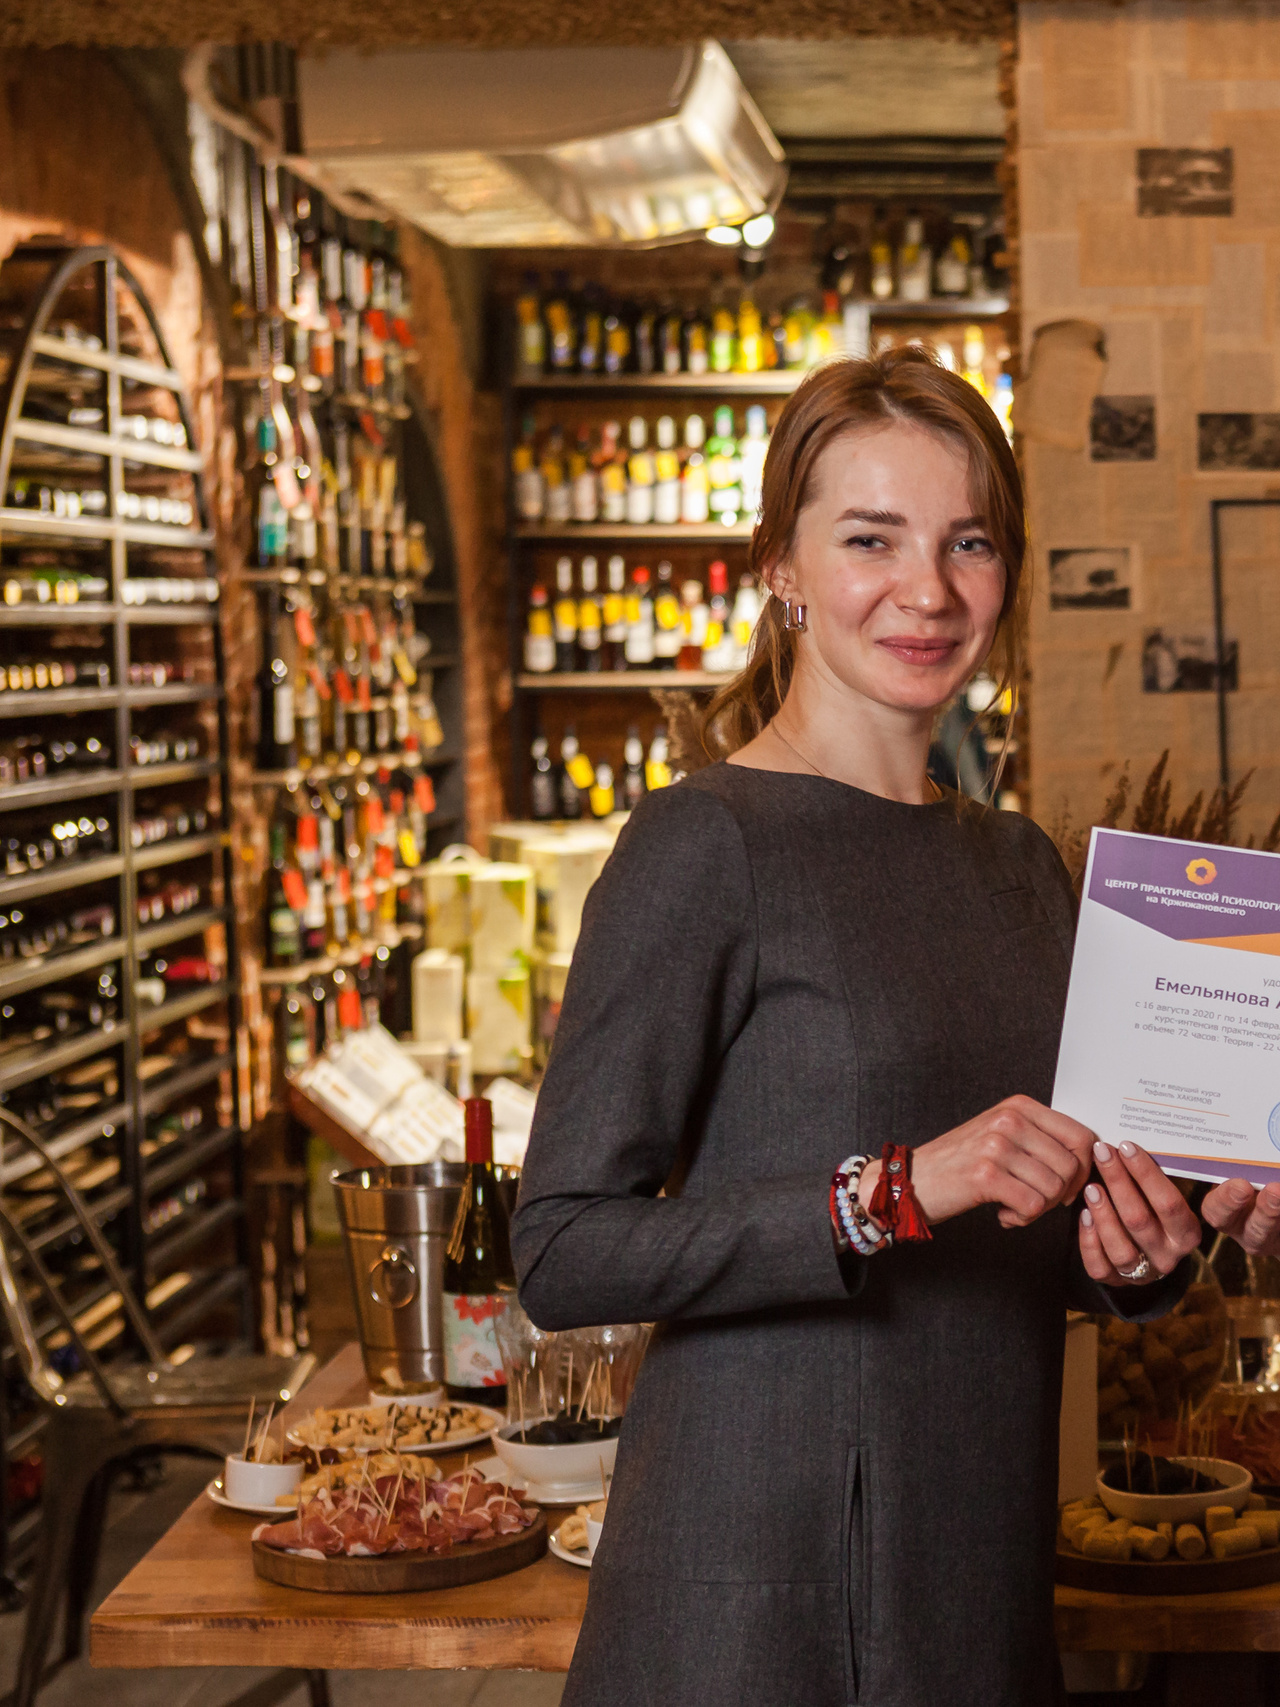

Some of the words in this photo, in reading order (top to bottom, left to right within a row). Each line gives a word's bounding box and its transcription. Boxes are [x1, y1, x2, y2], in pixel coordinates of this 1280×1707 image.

[1105, 879, 1138, 890] ЦЕНТР
[1140, 884, 1219, 902] ПРАКТИЧЕСКОЙ
[1161, 897, 1246, 916] Кржижановского
[1156, 977, 1269, 1007] Емельянова
[1156, 1005, 1189, 1015] августа
[1192, 1009, 1214, 1019] 2020
[1155, 1016, 1218, 1030] курс-интенсив
[1178, 1028, 1188, 1037] 72
[1192, 1032, 1218, 1042] часов:
[1224, 1036, 1253, 1047] Теория
[1263, 1043, 1274, 1051] 22
